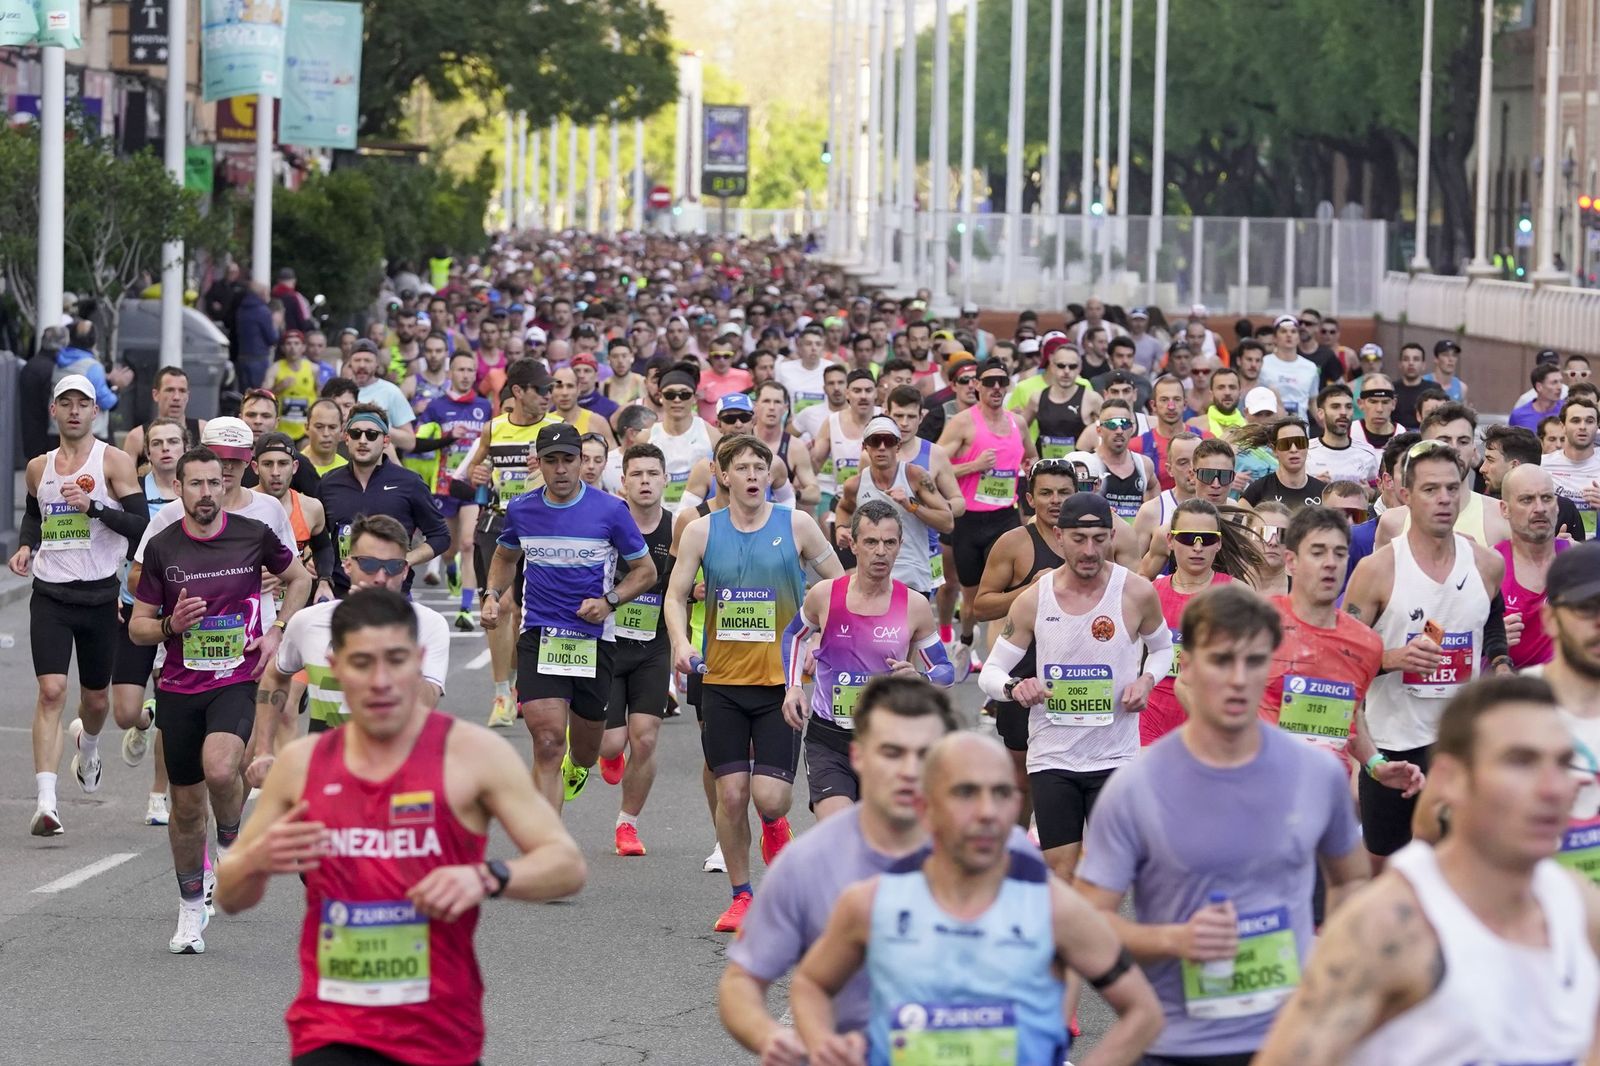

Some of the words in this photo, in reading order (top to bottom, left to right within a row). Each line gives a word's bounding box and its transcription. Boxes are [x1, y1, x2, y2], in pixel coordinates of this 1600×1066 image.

[493, 456, 527, 464] TRAVER
[57, 518, 73, 527] 2532
[43, 531, 58, 540] JAVI
[59, 529, 91, 538] GAYOSO
[185, 566, 254, 582] pinturasCARMAN
[735, 591, 768, 599] ZURICH
[626, 607, 642, 616] 1845
[736, 606, 755, 615] 2419
[622, 616, 641, 628] LEE
[721, 617, 770, 629] MICHAEL
[547, 652, 588, 665] DUCLOS
[1066, 668, 1105, 677] ZURICH
[1068, 686, 1088, 696] 2062
[1309, 682, 1350, 697] ZURICH
[1047, 698, 1067, 711] GIO
[1070, 698, 1112, 711] SHEEN
[1318, 725, 1350, 737] LORETO
[351, 905, 417, 924] ZURICH
[329, 956, 419, 978] RICARDO
